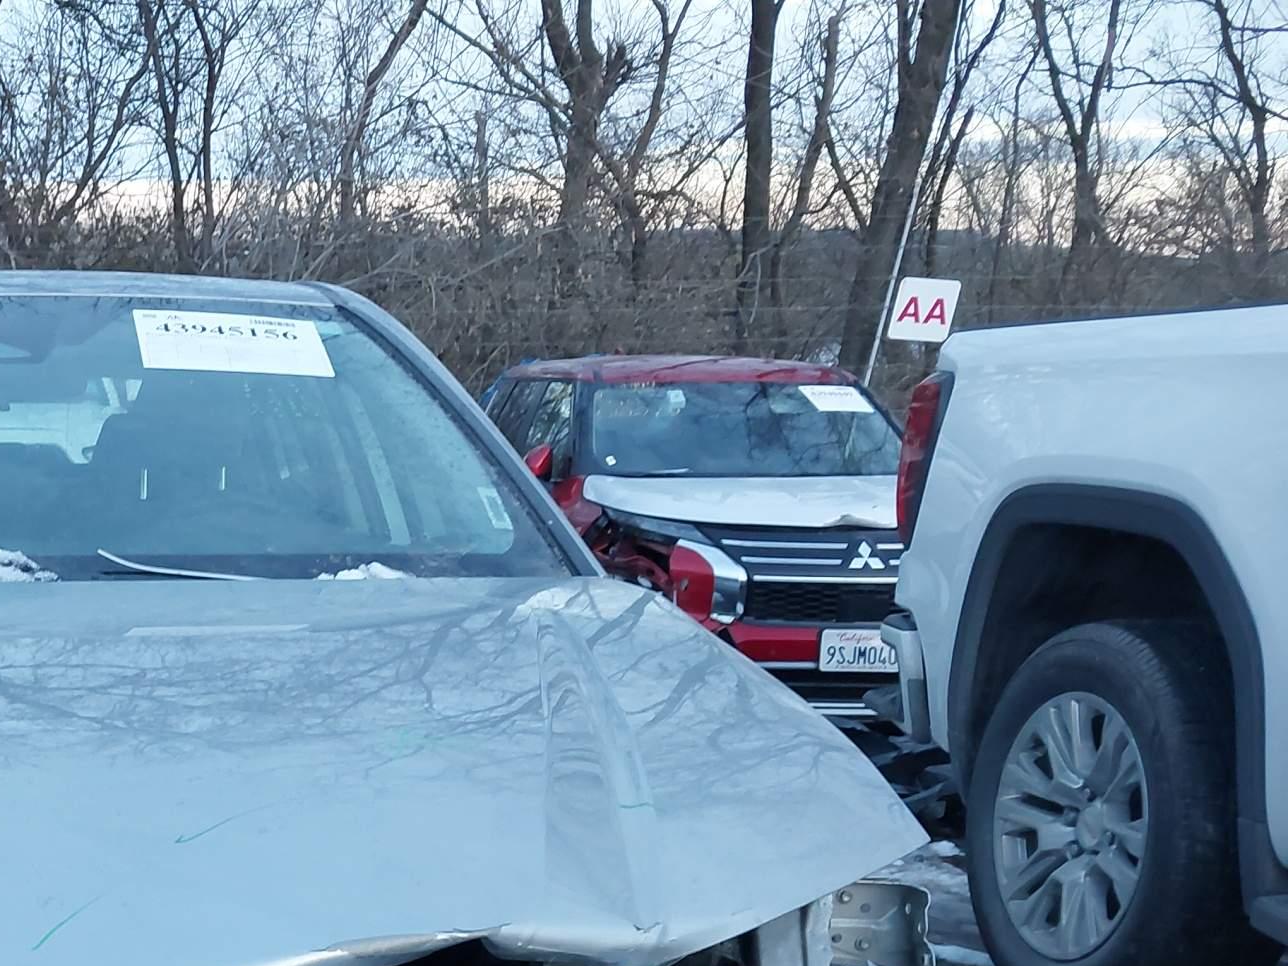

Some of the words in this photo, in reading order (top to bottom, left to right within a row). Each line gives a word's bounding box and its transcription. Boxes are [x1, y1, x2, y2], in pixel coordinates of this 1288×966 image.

[897, 296, 946, 325] AA
[156, 323, 298, 340] 43945156
[824, 645, 897, 665] 9SJM040
